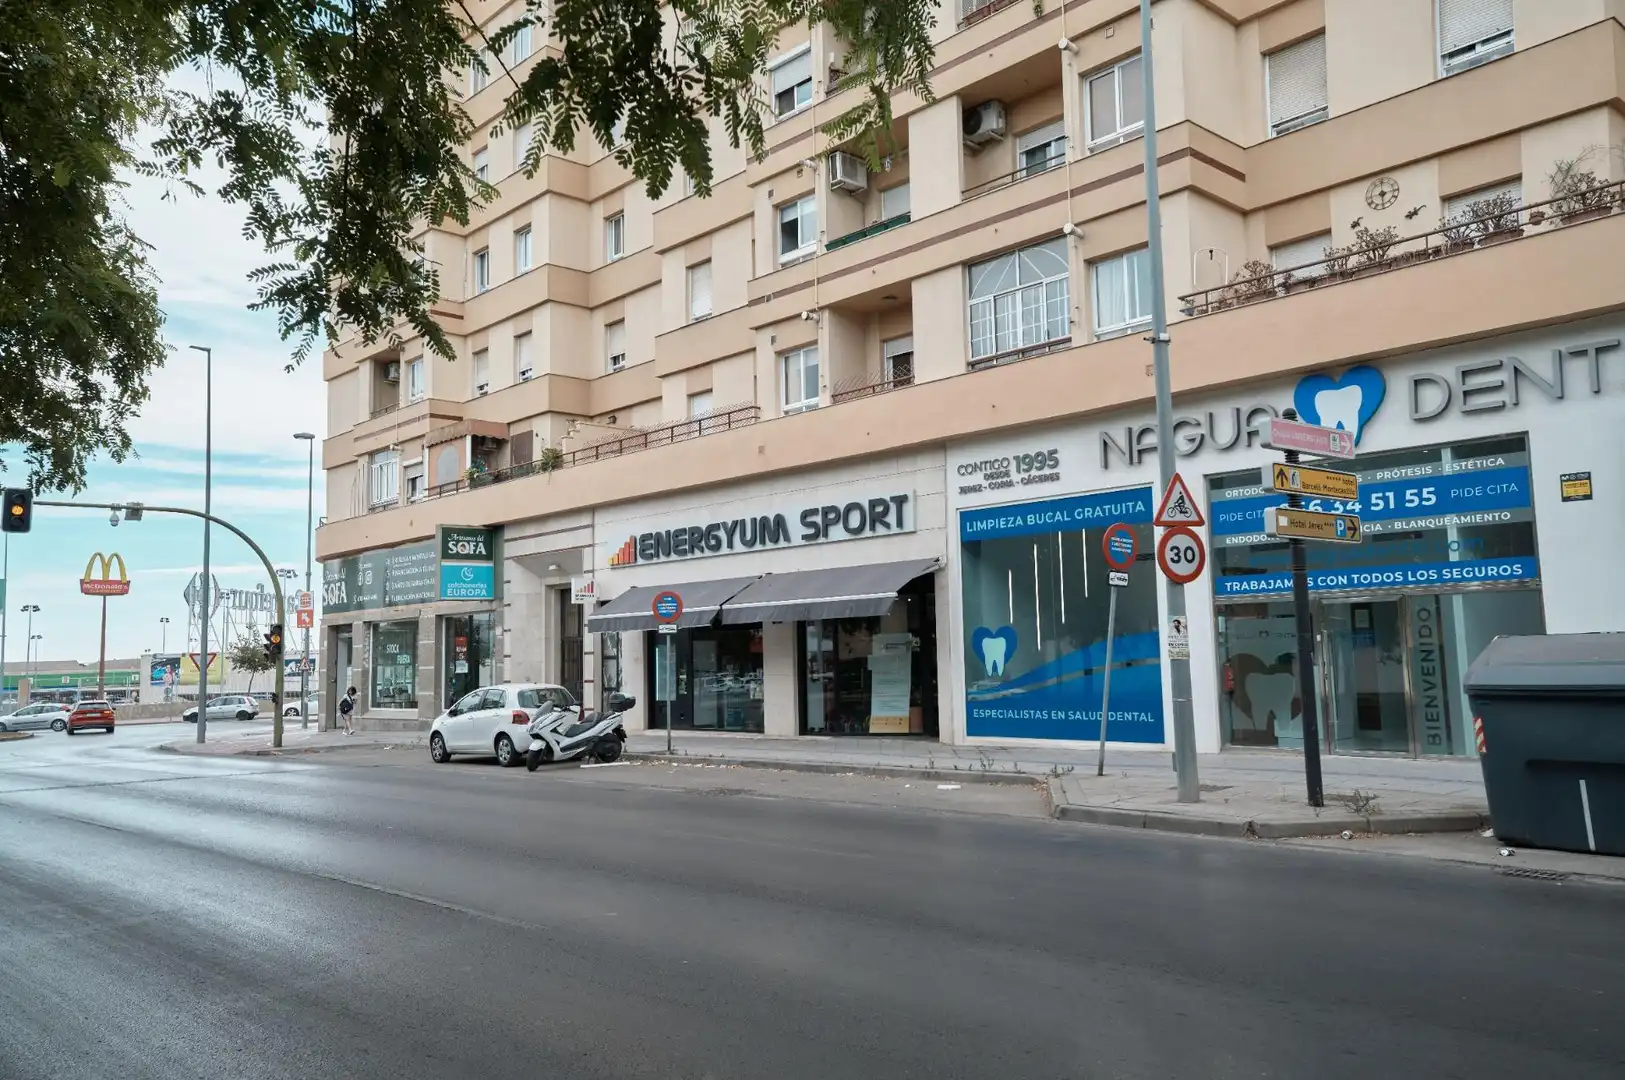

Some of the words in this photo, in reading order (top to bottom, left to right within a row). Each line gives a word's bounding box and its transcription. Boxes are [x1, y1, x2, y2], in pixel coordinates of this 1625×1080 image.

[1409, 339, 1621, 421] DENT
[957, 457, 1010, 476] CONTIGO
[1013, 448, 1060, 474] 1995
[1376, 465, 1433, 480] PRÓTESIS
[1445, 457, 1505, 472] ESTÉTICA
[983, 469, 1011, 481] DESDE
[958, 483, 983, 495] JEREZ
[988, 479, 1015, 490] CORIA
[1450, 486, 1483, 499] PIDE
[1487, 482, 1519, 495] CITA
[1370, 491, 1395, 511] 51
[1404, 487, 1437, 507] 55
[638, 513, 792, 560] ENERGYUM
[800, 494, 909, 541] SPORT
[966, 515, 1023, 533] LIMPIEZA
[1027, 510, 1072, 526] BUCAL
[1074, 500, 1146, 521] GRATUITA
[1219, 512, 1244, 522] PIDE
[1394, 511, 1511, 530] BLANQUEAMIENTO
[1169, 545, 1196, 564] 30
[1225, 577, 1314, 591] TRABAJAMS
[1317, 575, 1348, 586] CON
[1352, 571, 1403, 584] TODOS
[1408, 569, 1437, 582] LOS
[1442, 564, 1522, 579] SEGUROS
[447, 588, 487, 597] EUROPA
[1417, 607, 1442, 746] BIENVENIDO
[973, 708, 1049, 720] ESPECIALISTAS
[1051, 710, 1064, 720] EN
[1068, 710, 1104, 721] SALUD
[1108, 711, 1155, 722] DENTAL
